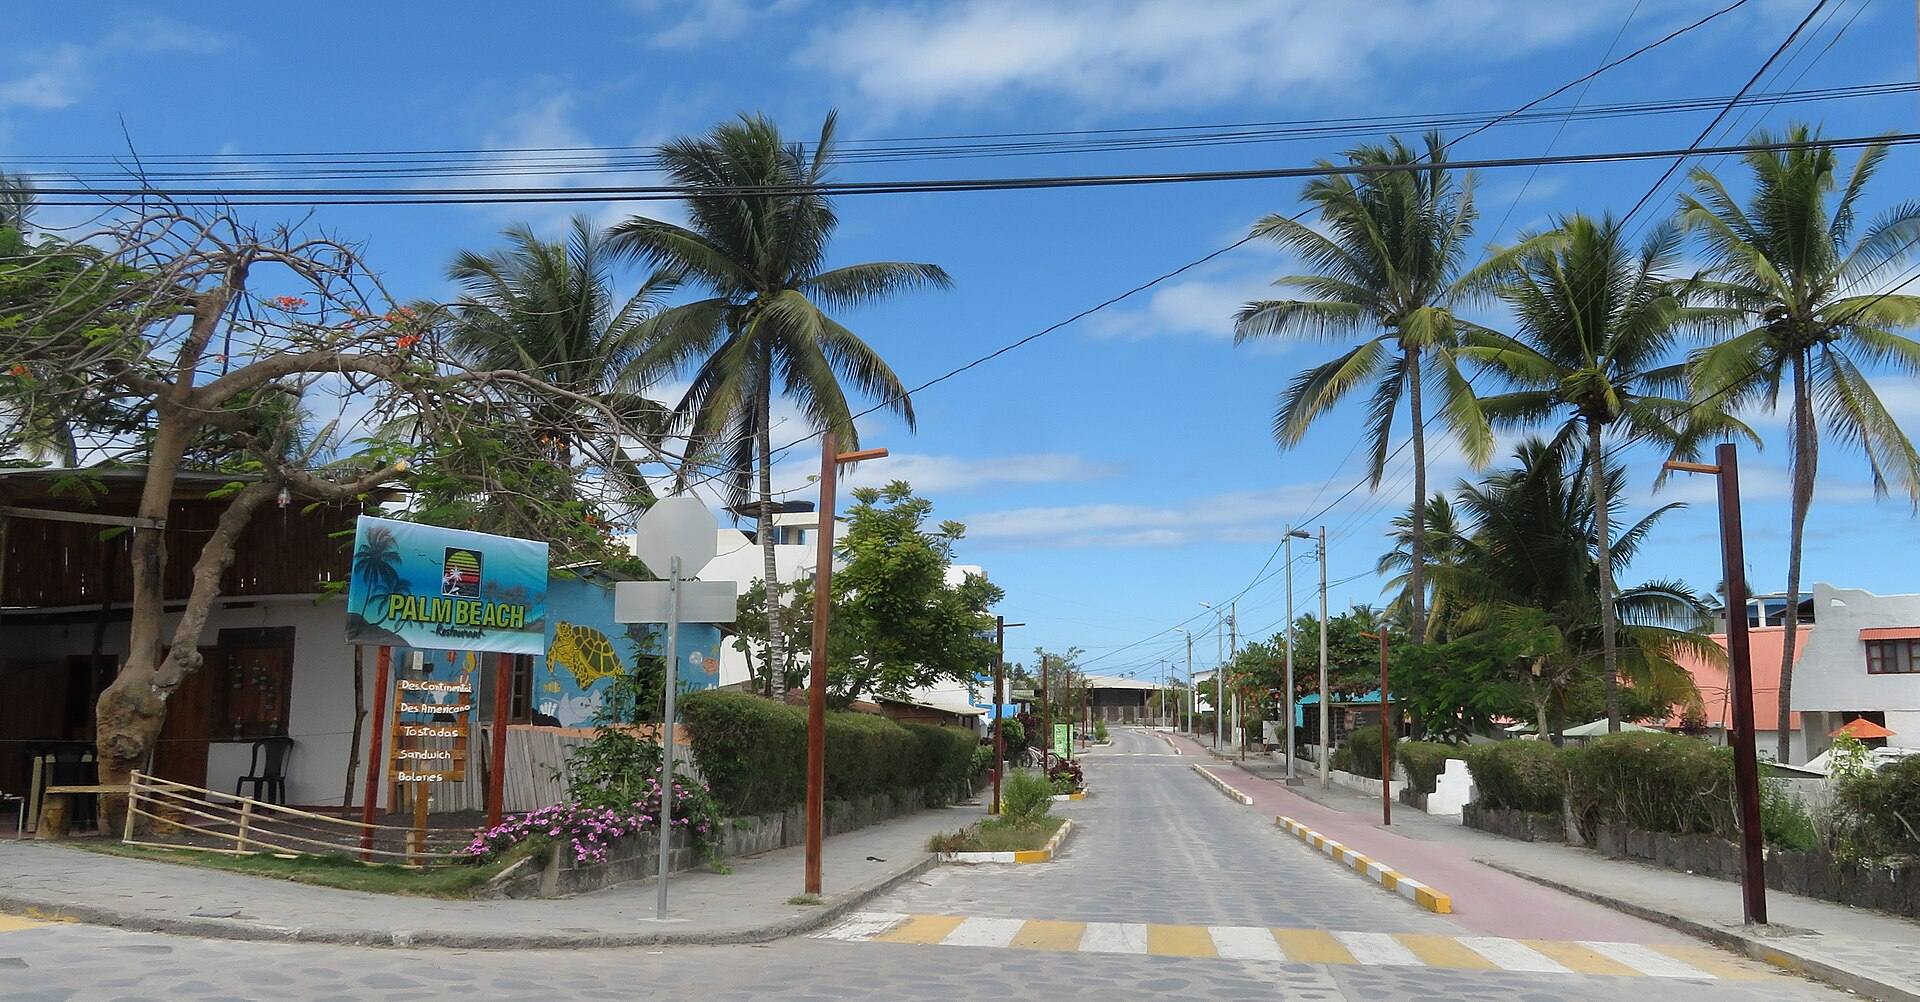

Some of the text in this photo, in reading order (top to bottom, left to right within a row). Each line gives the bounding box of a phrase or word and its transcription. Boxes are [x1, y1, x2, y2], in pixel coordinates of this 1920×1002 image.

[388, 594, 525, 629] PALM BEACH
[421, 703, 471, 714] Americano
[404, 726, 459, 738] Tostadas
[398, 749, 451, 760] Sandwich
[398, 771, 443, 782] Bolones
